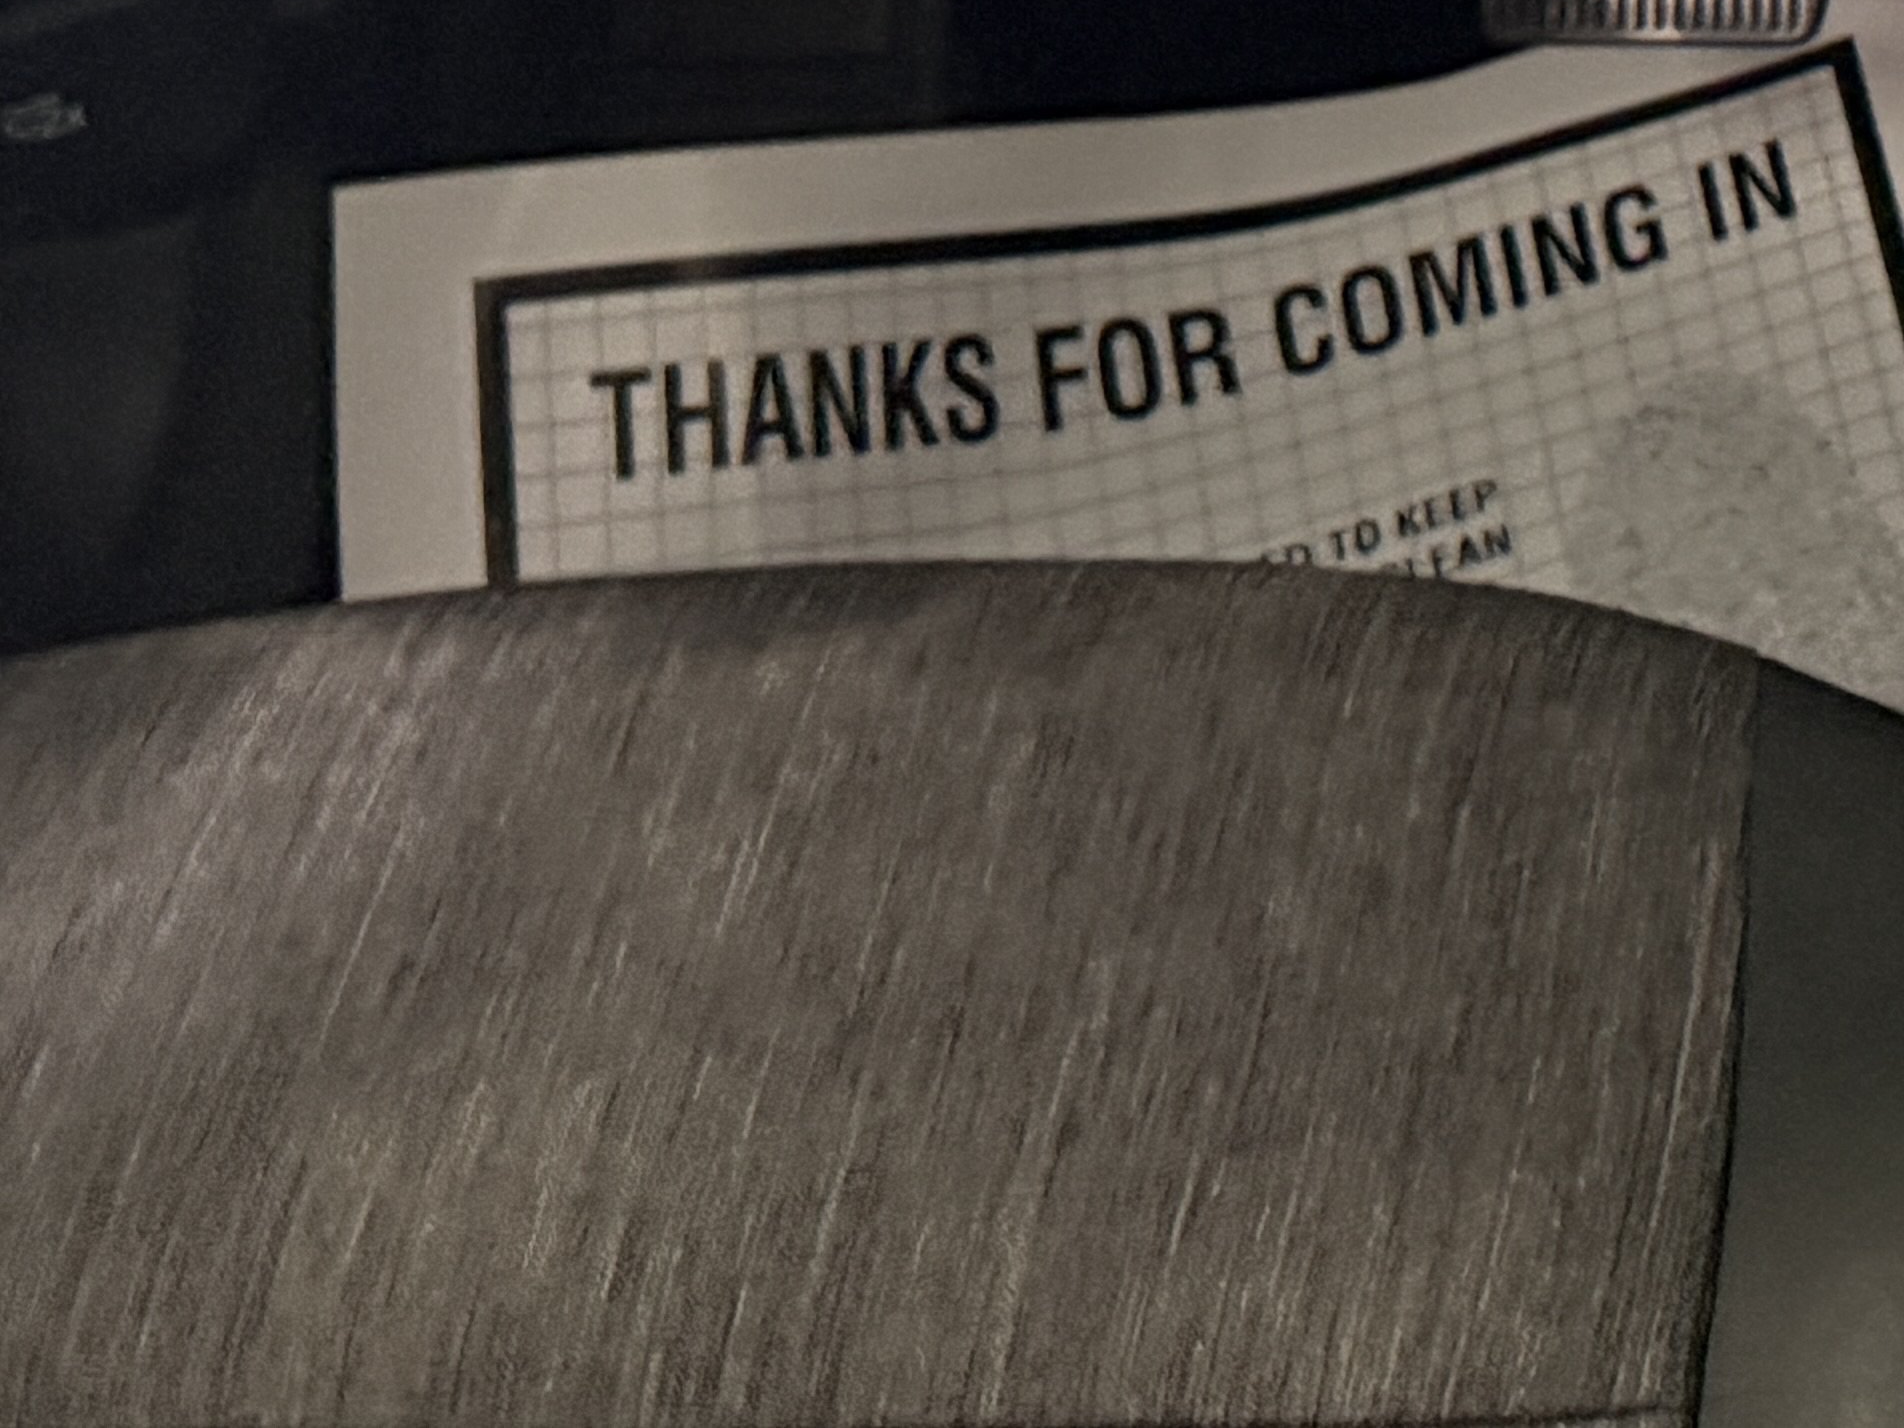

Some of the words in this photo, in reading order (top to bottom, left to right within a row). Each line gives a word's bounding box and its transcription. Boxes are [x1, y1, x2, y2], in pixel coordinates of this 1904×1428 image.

[588, 332, 999, 480] THANKS
[1034, 308, 1240, 432] FOR
[1272, 182, 1669, 376] COMING
[1697, 138, 1798, 241] IN
[1329, 518, 1381, 562] TO
